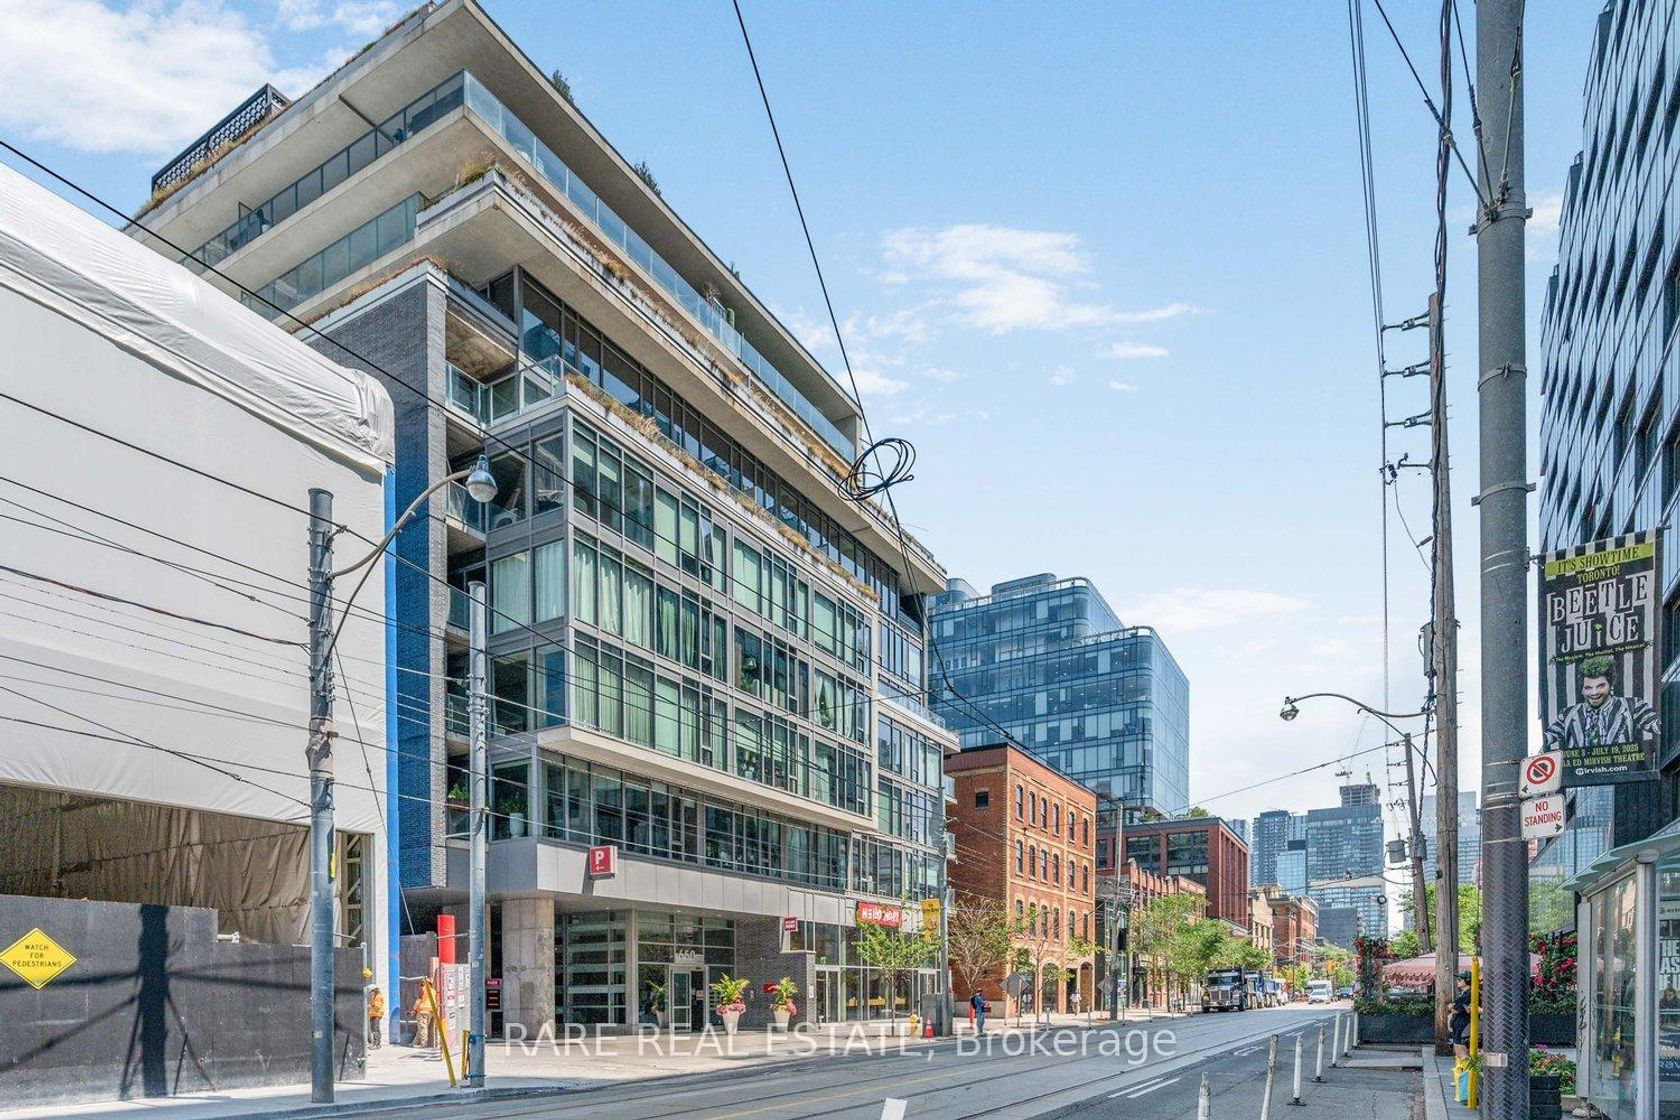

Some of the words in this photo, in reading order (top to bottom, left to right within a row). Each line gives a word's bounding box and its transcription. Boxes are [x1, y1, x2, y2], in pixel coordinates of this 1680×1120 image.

[1557, 559, 1576, 574] IT'S
[1580, 547, 1639, 569] SHOWTIME
[1576, 565, 1620, 584] TORONTO!
[1552, 575, 1648, 622] BEETLE
[1563, 749, 1580, 759] UNE
[1592, 746, 1609, 756] JULY
[1573, 758, 1582, 767] ED
[1613, 752, 1645, 764] THEATRE
[1536, 801, 1548, 812] NO
[1524, 811, 1562, 827] STANDING
[595, 850, 604, 865] P
[12, 959, 62, 967] PEDESTRIANS
